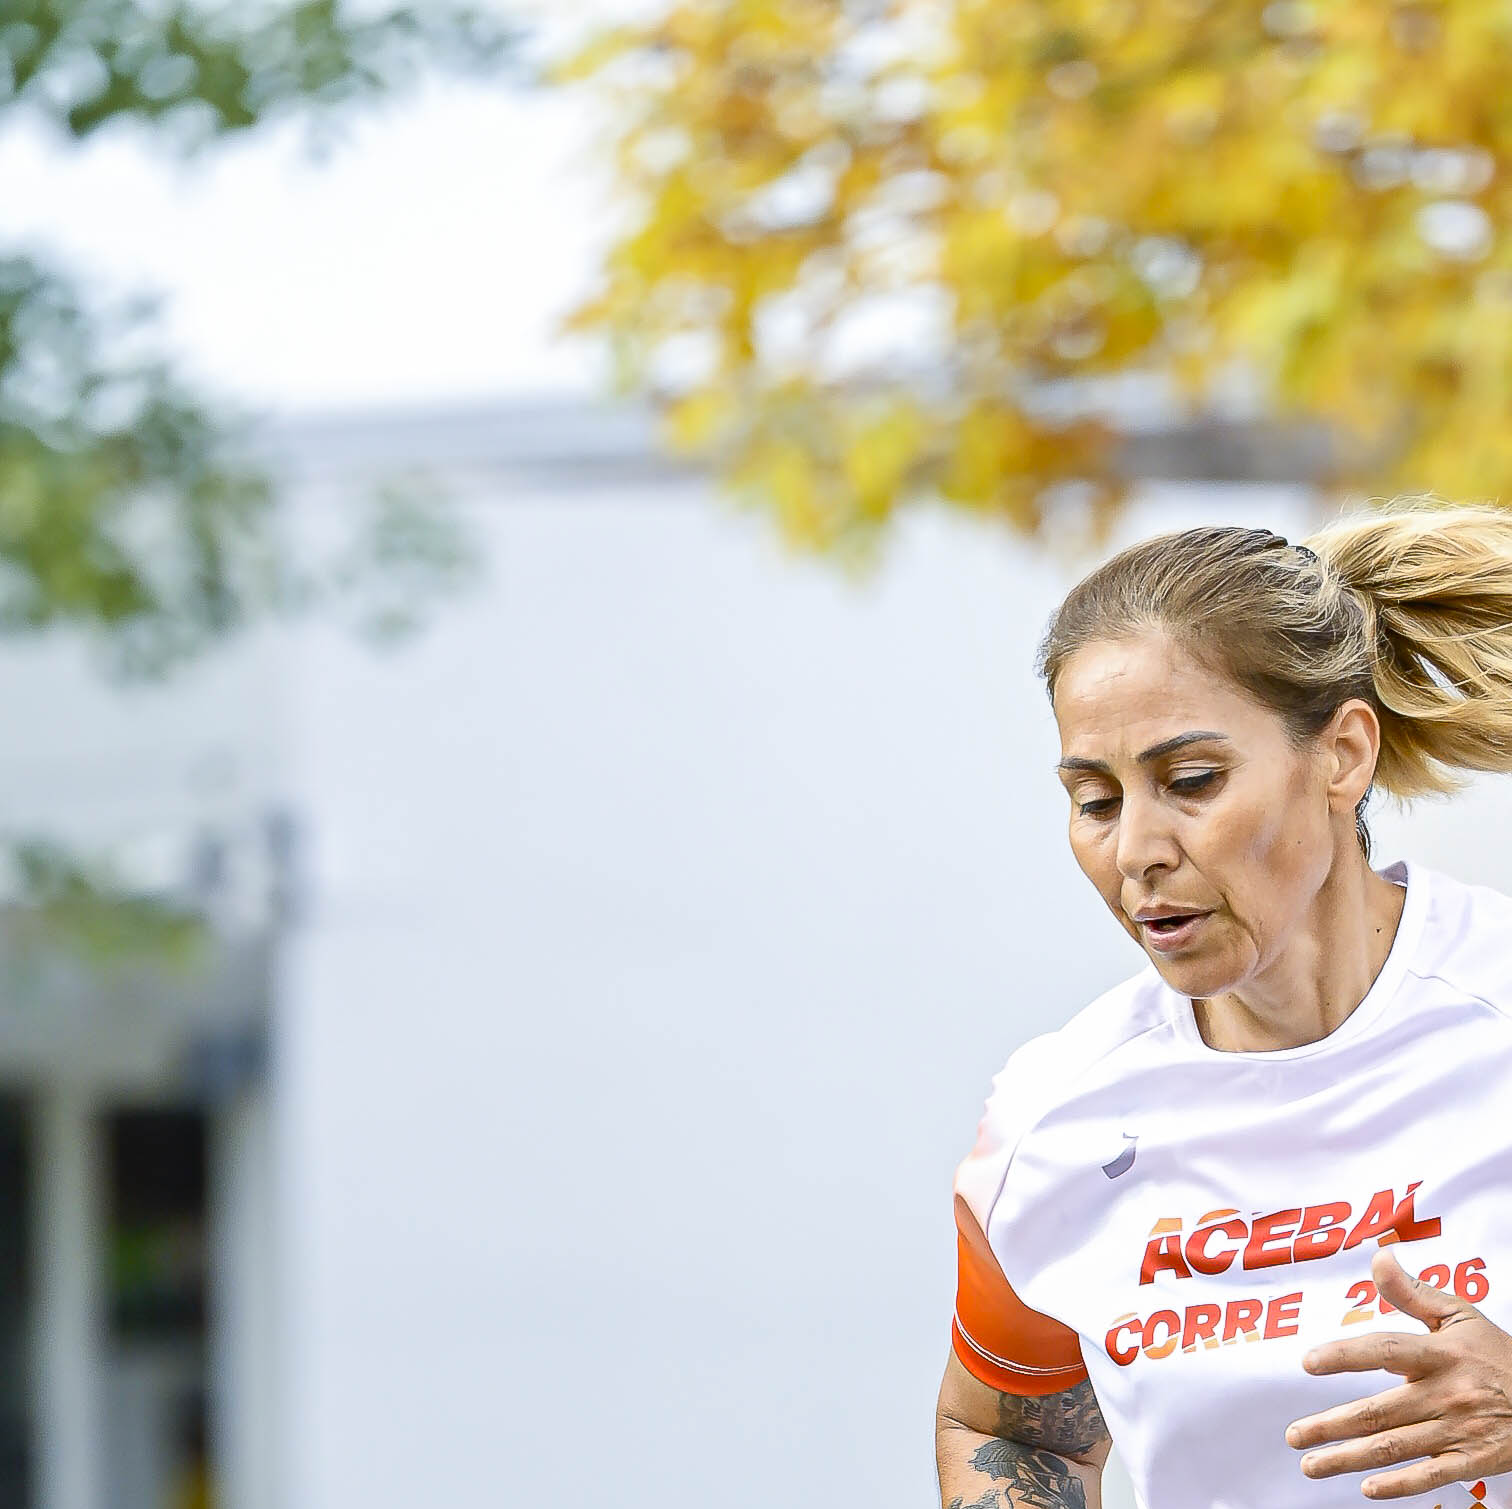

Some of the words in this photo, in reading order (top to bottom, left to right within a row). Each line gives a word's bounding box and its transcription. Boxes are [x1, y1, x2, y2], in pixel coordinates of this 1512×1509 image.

[1138, 1180, 1442, 1286] ACEBAL
[1105, 1292, 1304, 1367] CORRE
[1341, 1257, 1490, 1326] 226
